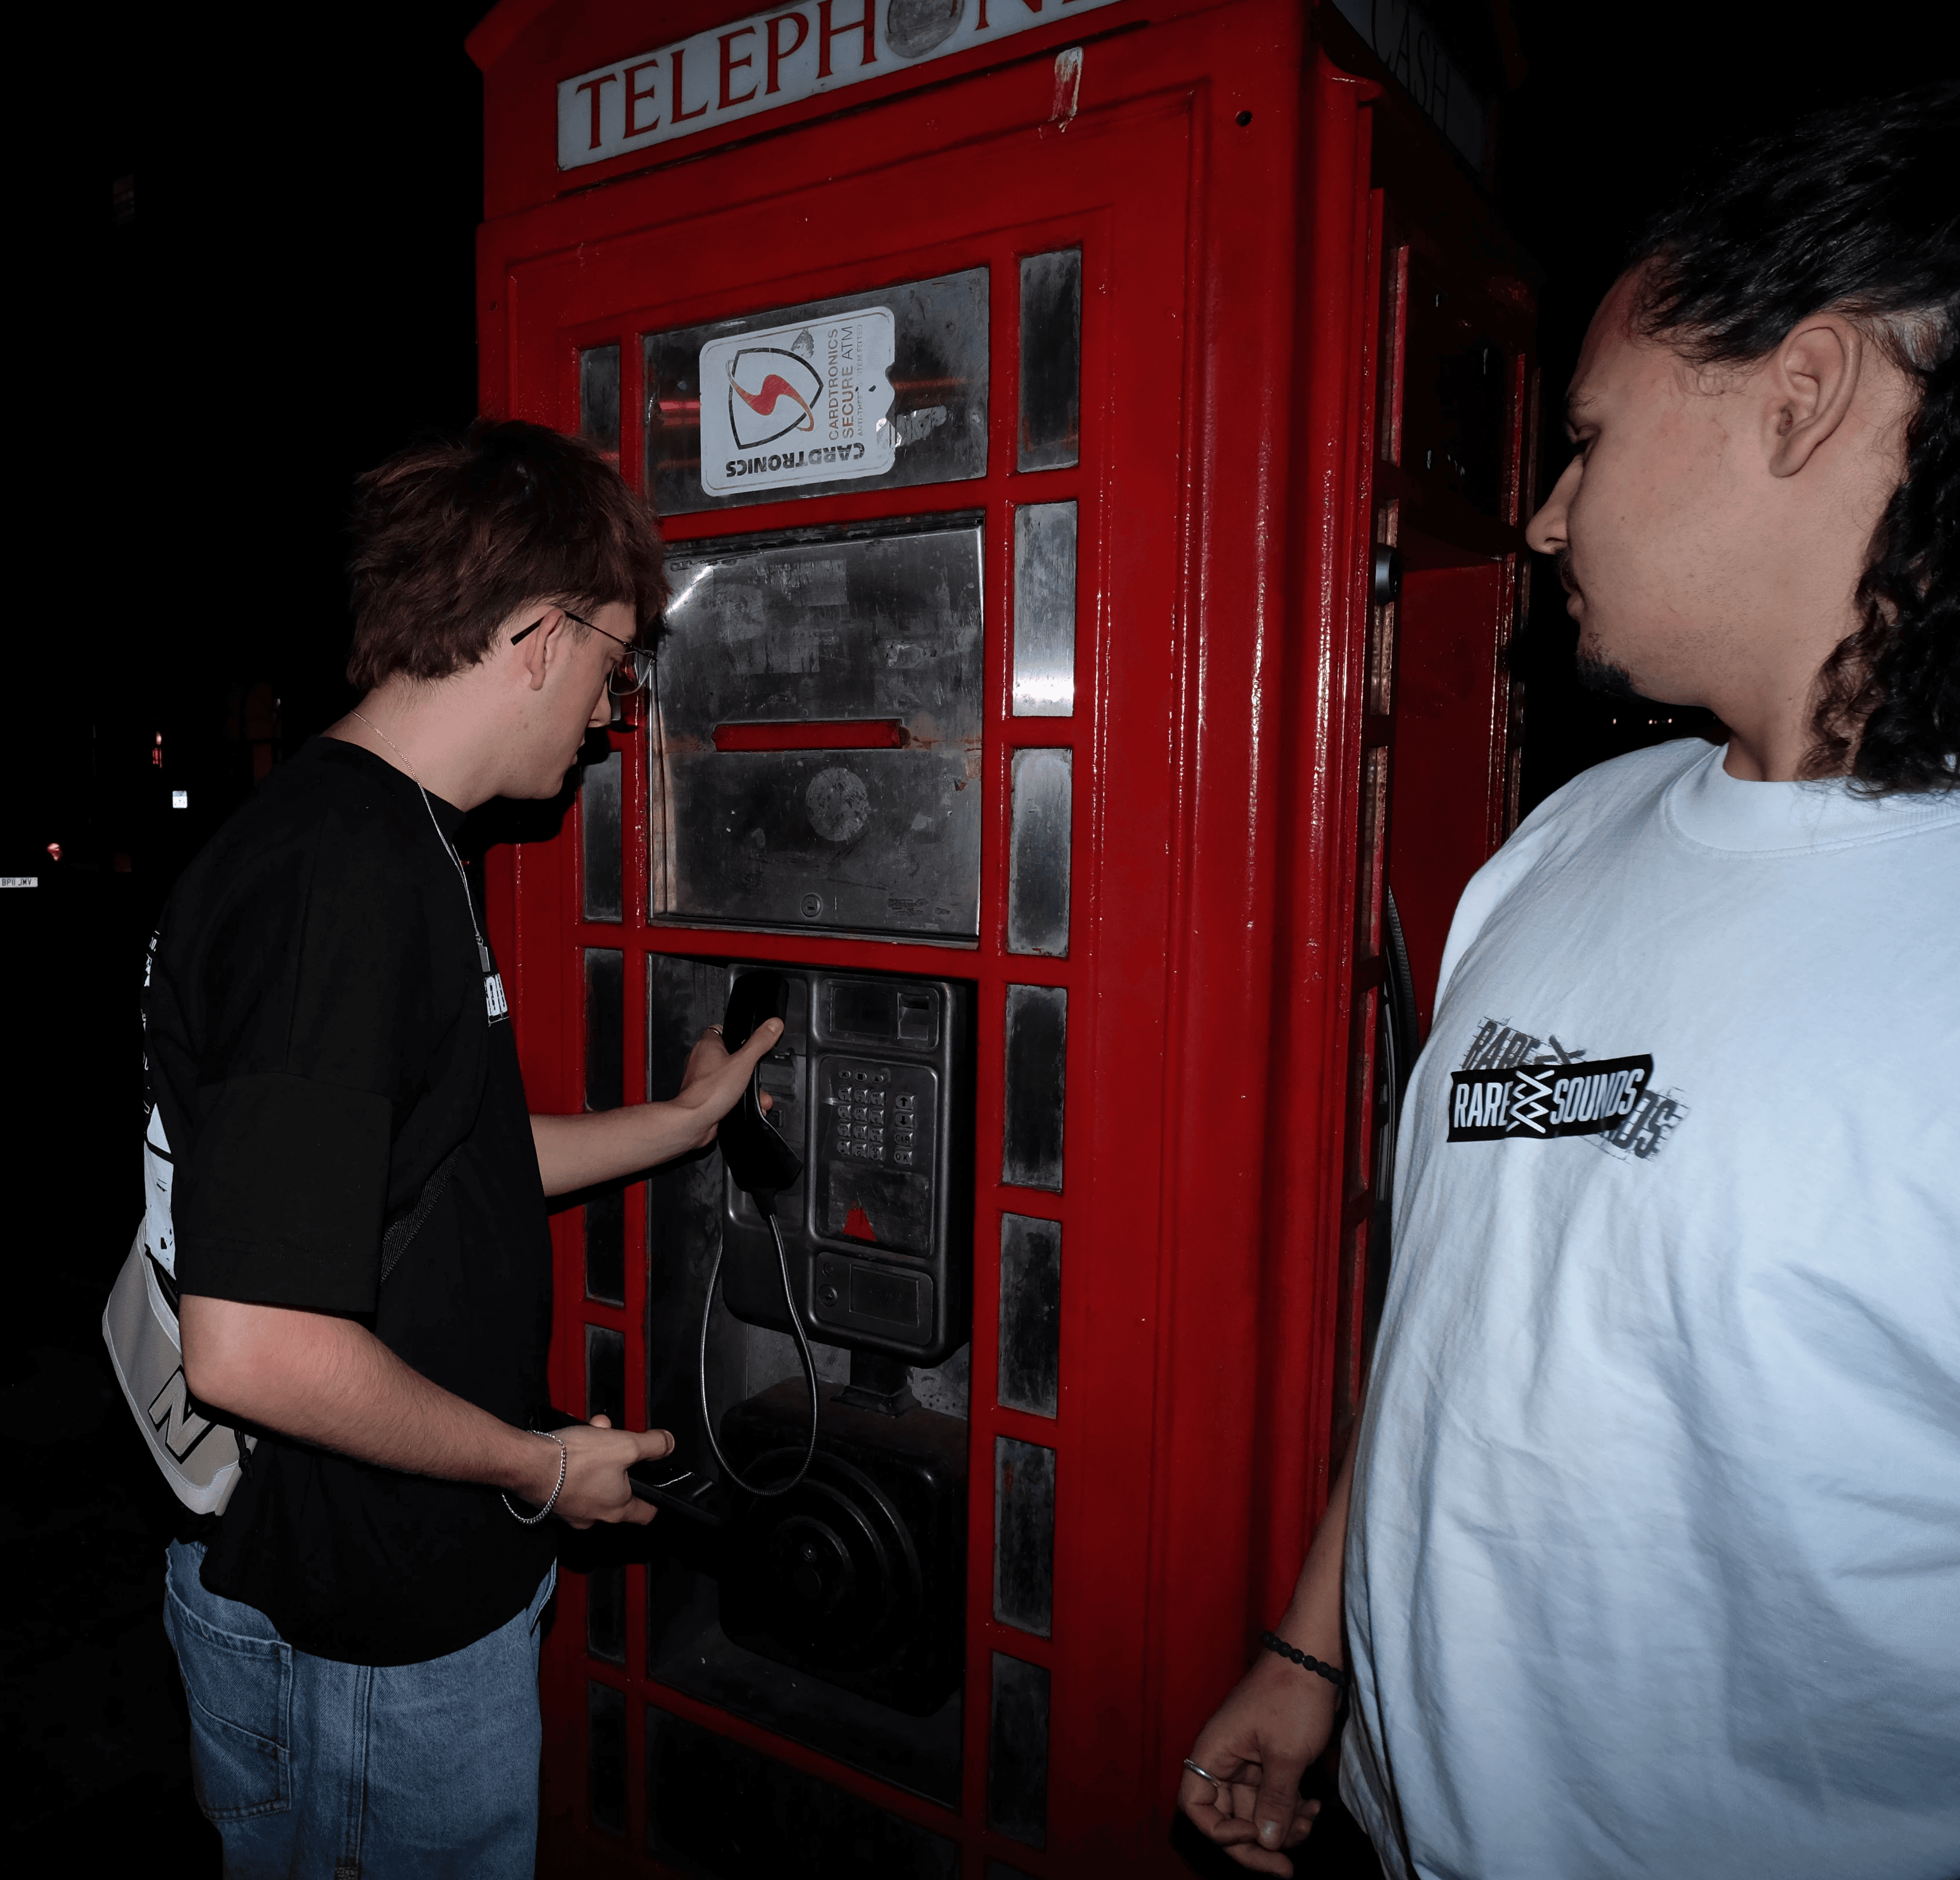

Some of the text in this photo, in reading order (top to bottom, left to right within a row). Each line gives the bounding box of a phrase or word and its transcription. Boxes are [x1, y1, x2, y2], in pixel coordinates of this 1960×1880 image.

[576, 0, 1079, 150] TELEPH
[828, 328, 839, 440] CARDTRONICS
[841, 326, 854, 439] SECURE ATM
[726, 442, 865, 477] CARDTRONICS
[1453, 1080, 1514, 1128] RARE
[1549, 1068, 1646, 1126] SOUNDS
[896, 1135, 910, 1144] CLR
[896, 1153, 908, 1162] OK
